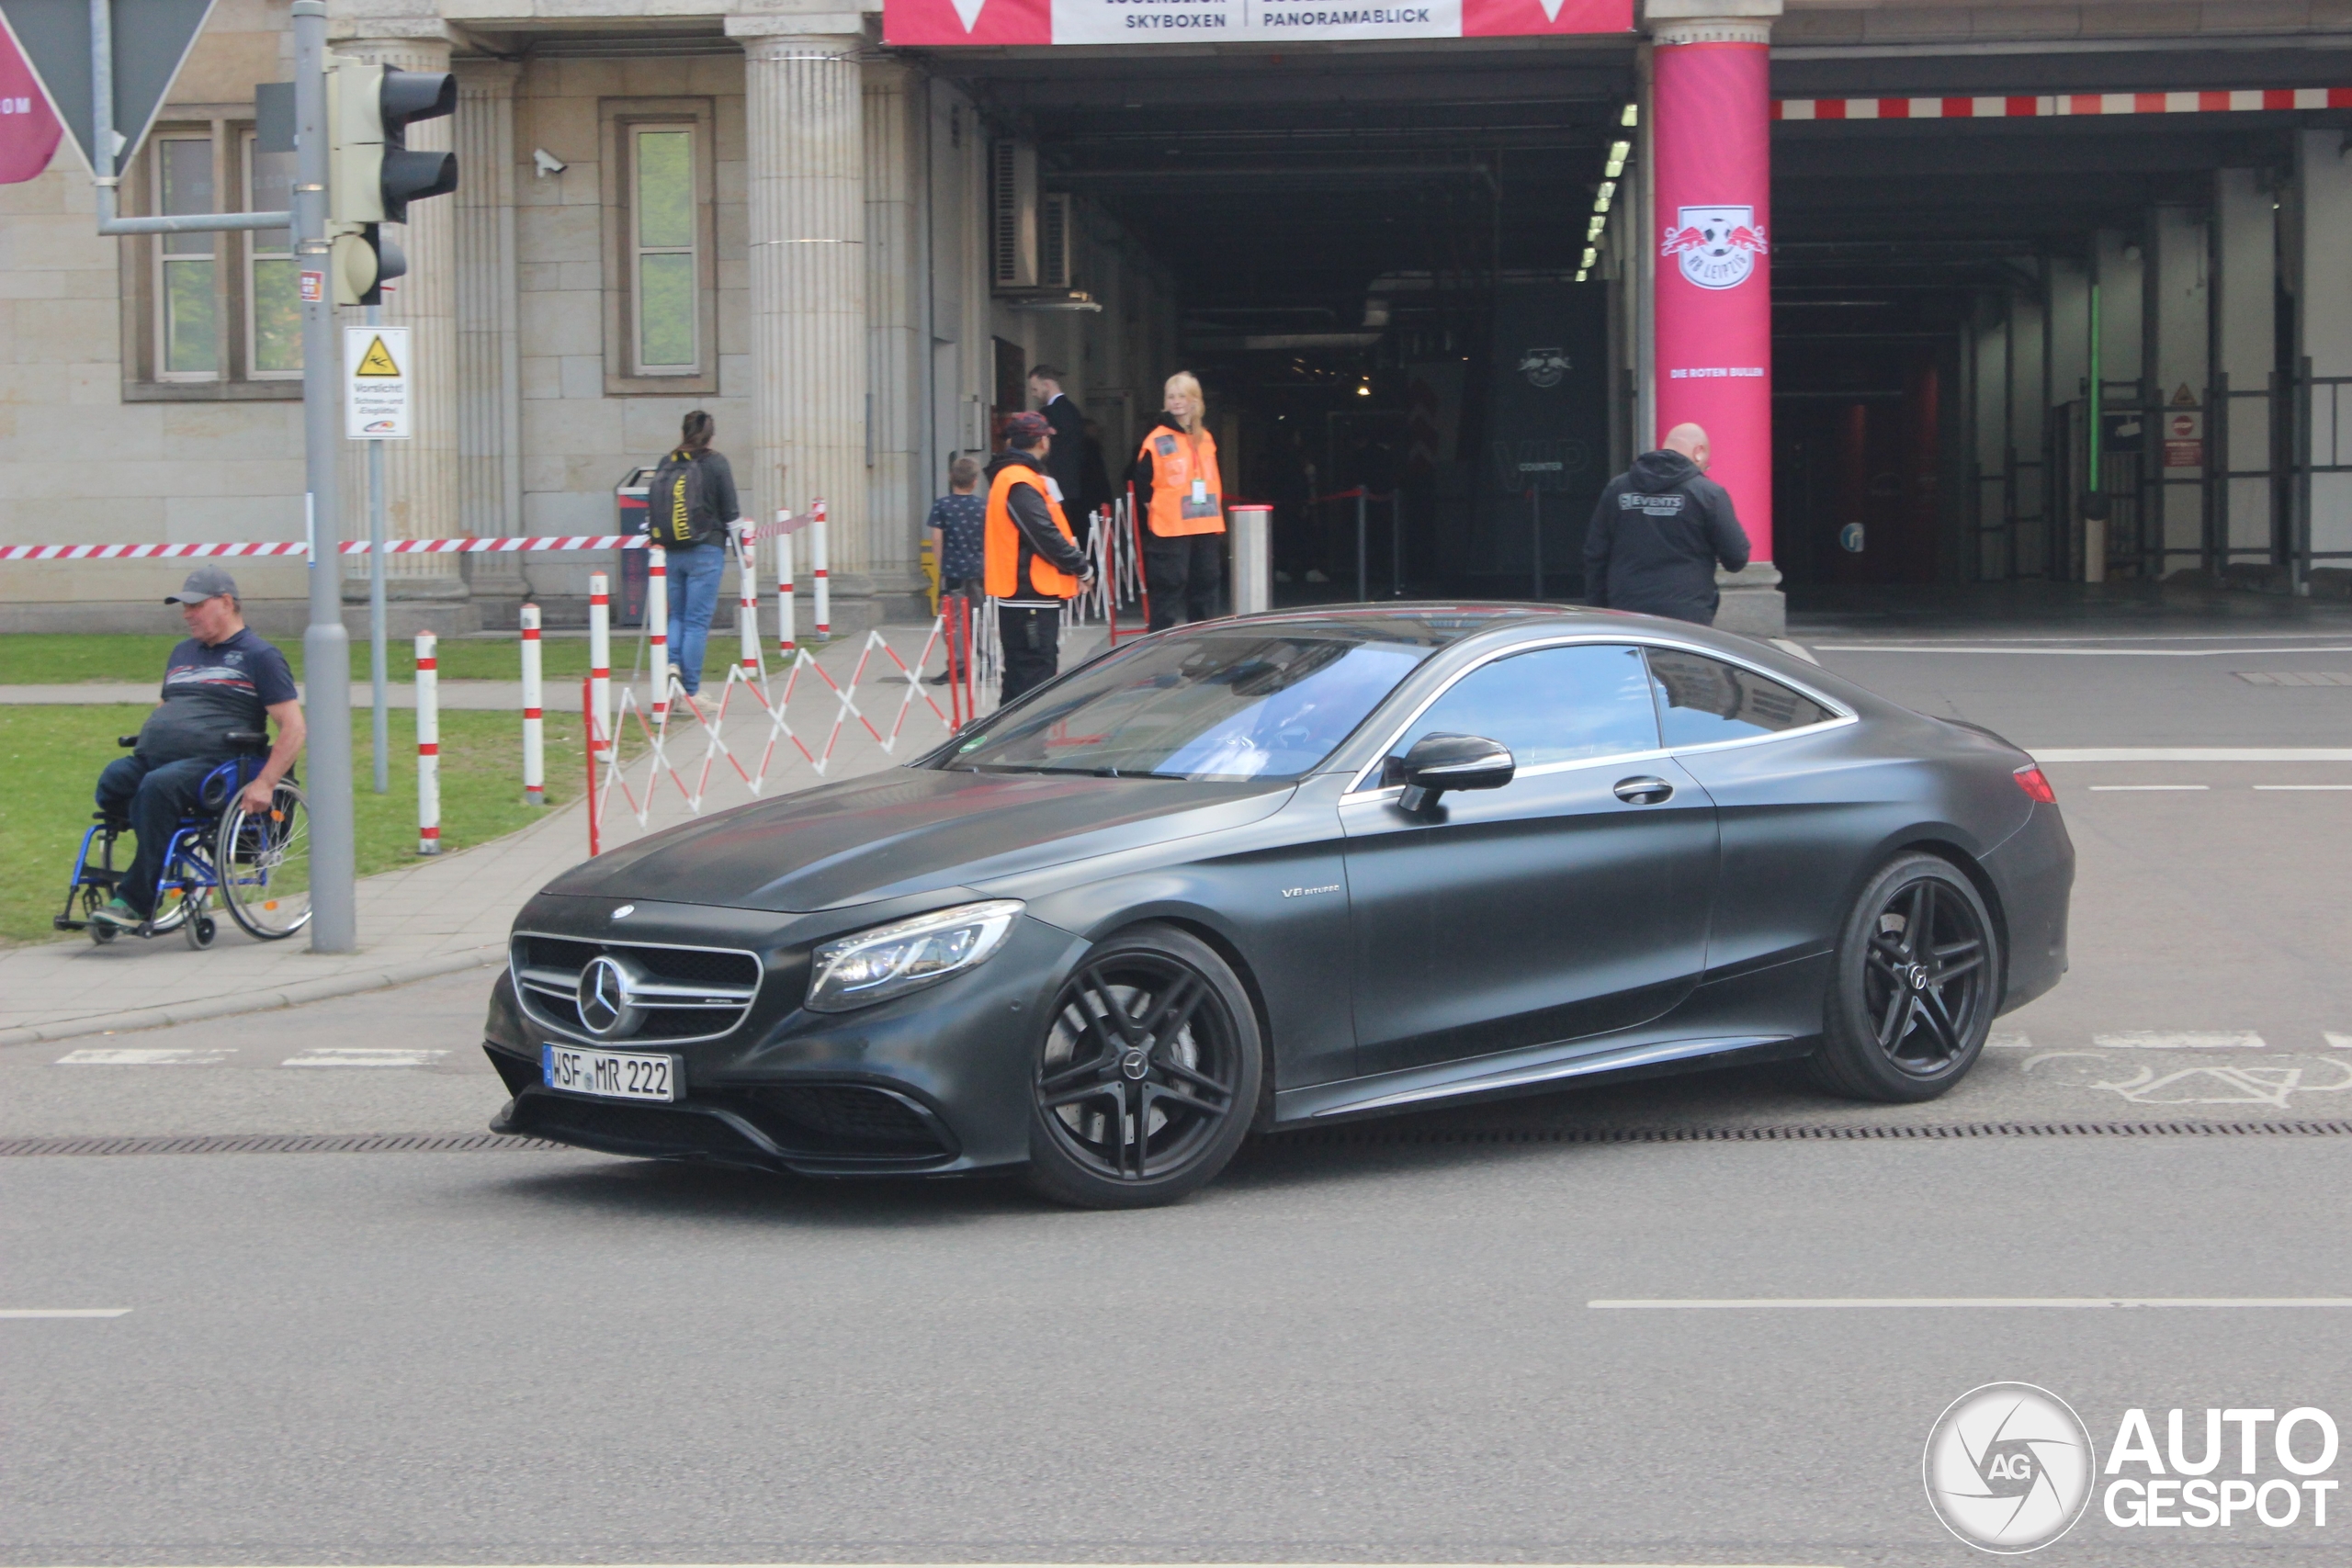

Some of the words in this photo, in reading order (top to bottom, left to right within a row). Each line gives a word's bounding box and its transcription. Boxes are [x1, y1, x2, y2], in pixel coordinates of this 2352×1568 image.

[1126, 14, 1226, 28] SKYBOXEN
[1263, 8, 1430, 27] PANORAMABLICK
[1703, 254, 1747, 279] LEIPZIG
[1689, 367, 1727, 378] ROTEN
[1634, 496, 1681, 507] EVENTS
[1281, 887, 1303, 898] V8
[552, 1051, 581, 1087] WSF
[595, 1057, 621, 1092] MR
[628, 1060, 669, 1095] 222
